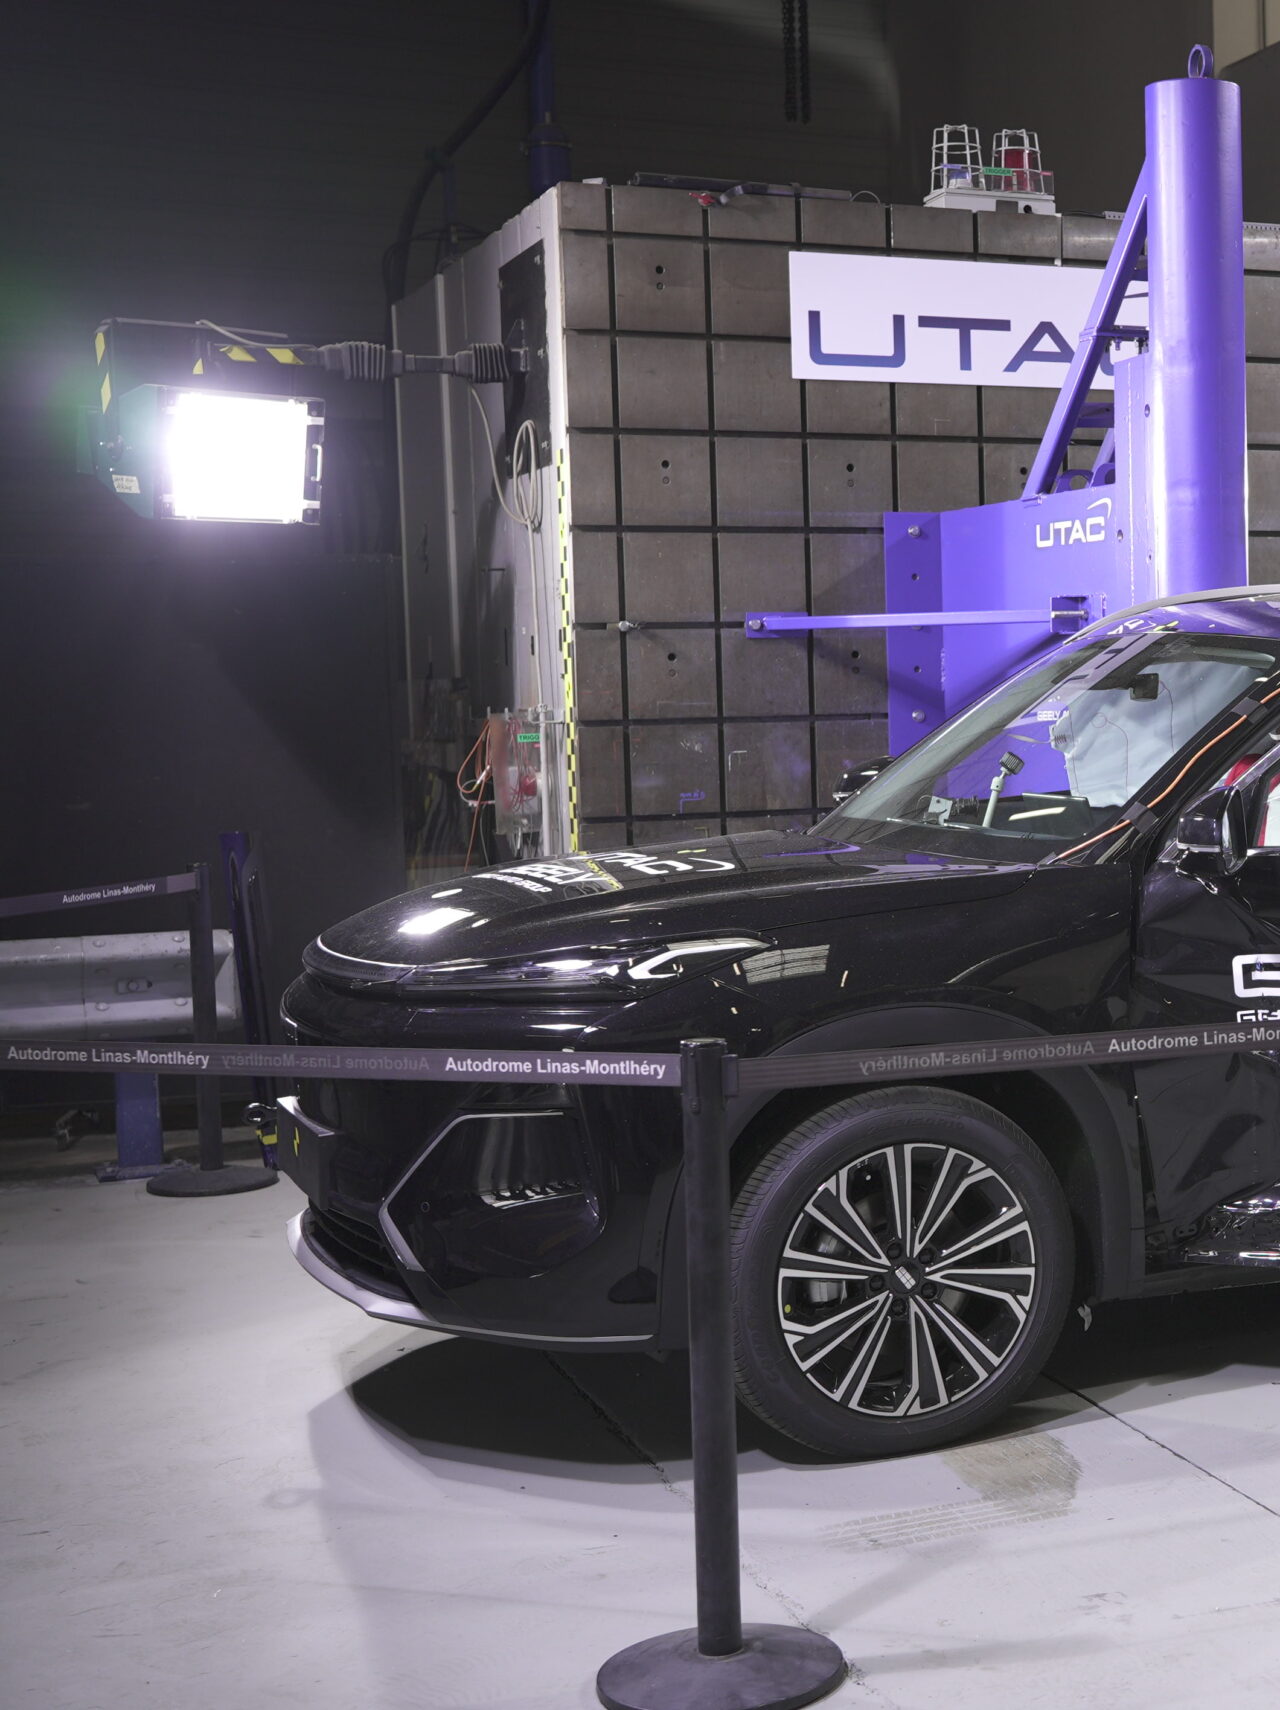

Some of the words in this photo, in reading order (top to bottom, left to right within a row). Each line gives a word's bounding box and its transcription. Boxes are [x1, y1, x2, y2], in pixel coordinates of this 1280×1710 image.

[984, 167, 1011, 176] TRIGGER
[808, 310, 1114, 376] UTA
[1036, 515, 1105, 548] UTAC
[62, 891, 102, 904] Autodrome
[102, 882, 157, 898] Linas-Montlhéry
[1108, 1033, 1199, 1053] Autodrome
[8, 1046, 88, 1061] Autodrome
[92, 1048, 210, 1069] Linas-Montlhéry
[445, 1057, 532, 1073] Autodrome
[537, 1059, 666, 1079] Linas-Montlhéry
